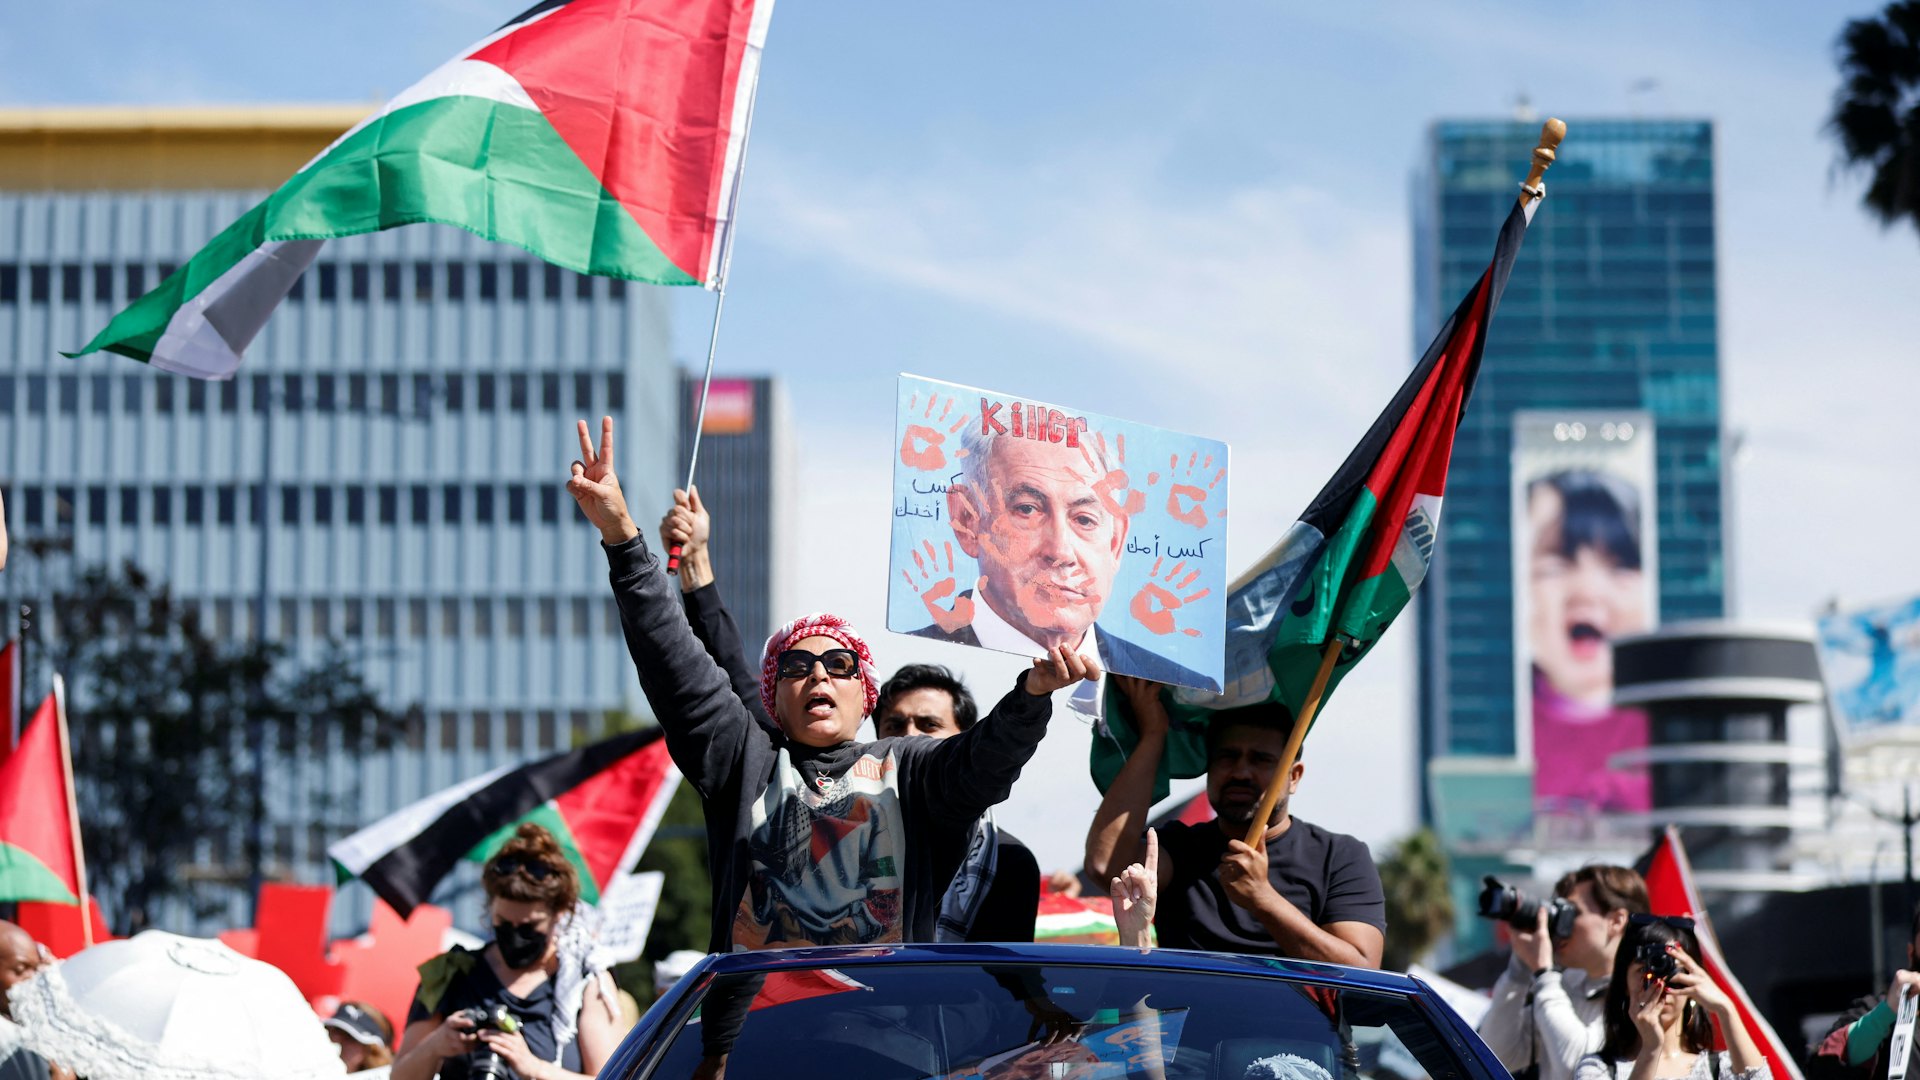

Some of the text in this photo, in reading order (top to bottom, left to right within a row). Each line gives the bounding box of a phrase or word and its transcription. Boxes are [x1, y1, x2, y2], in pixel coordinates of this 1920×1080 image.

[981, 397, 1088, 448] Killer
[1127, 534, 1214, 559] كس أمك
